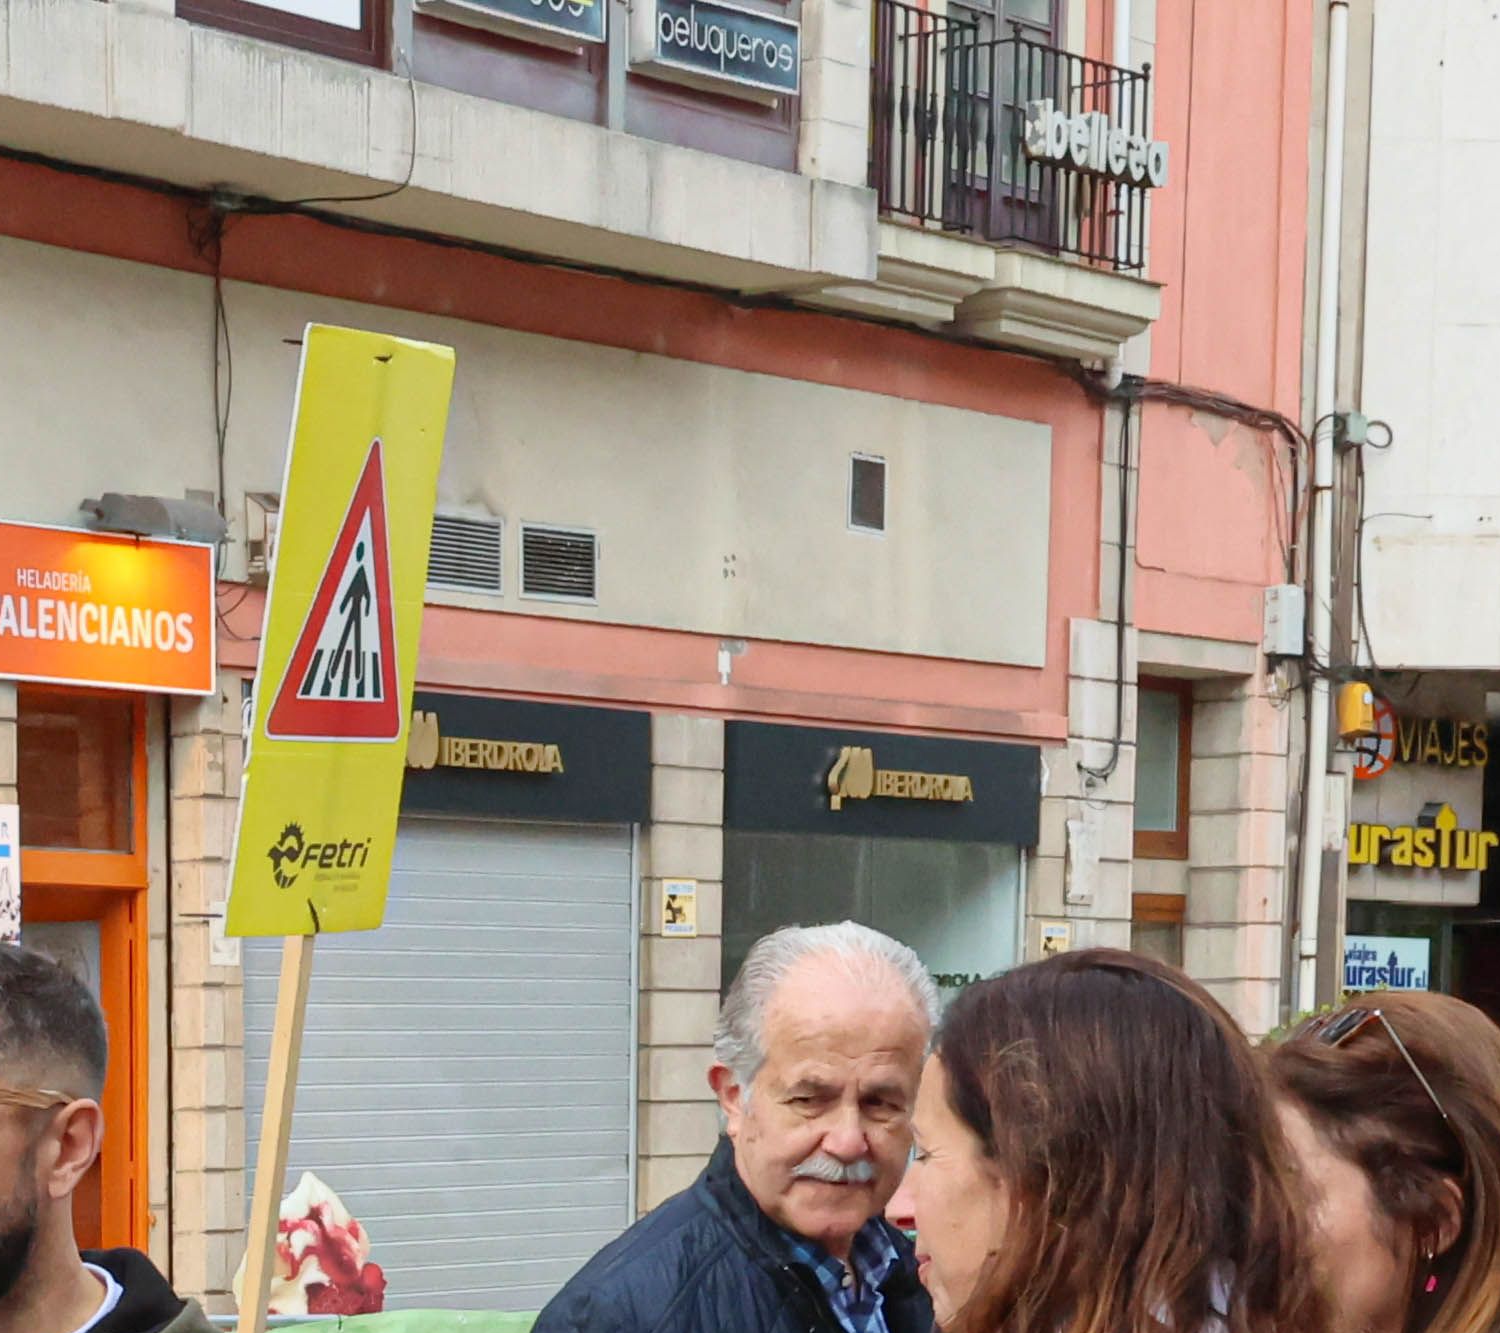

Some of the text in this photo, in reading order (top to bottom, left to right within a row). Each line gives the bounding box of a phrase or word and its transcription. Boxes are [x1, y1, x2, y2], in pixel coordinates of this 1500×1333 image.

[658, 11, 794, 72] peluqueros
[16, 567, 92, 595] HELADERÍA
[441, 736, 564, 774] IBERDROLA
[1399, 720, 1489, 768] VIAJES
[874, 769, 974, 803] IBERDROLA
[301, 837, 372, 869] fetri
[1348, 803, 1499, 871] urastur
